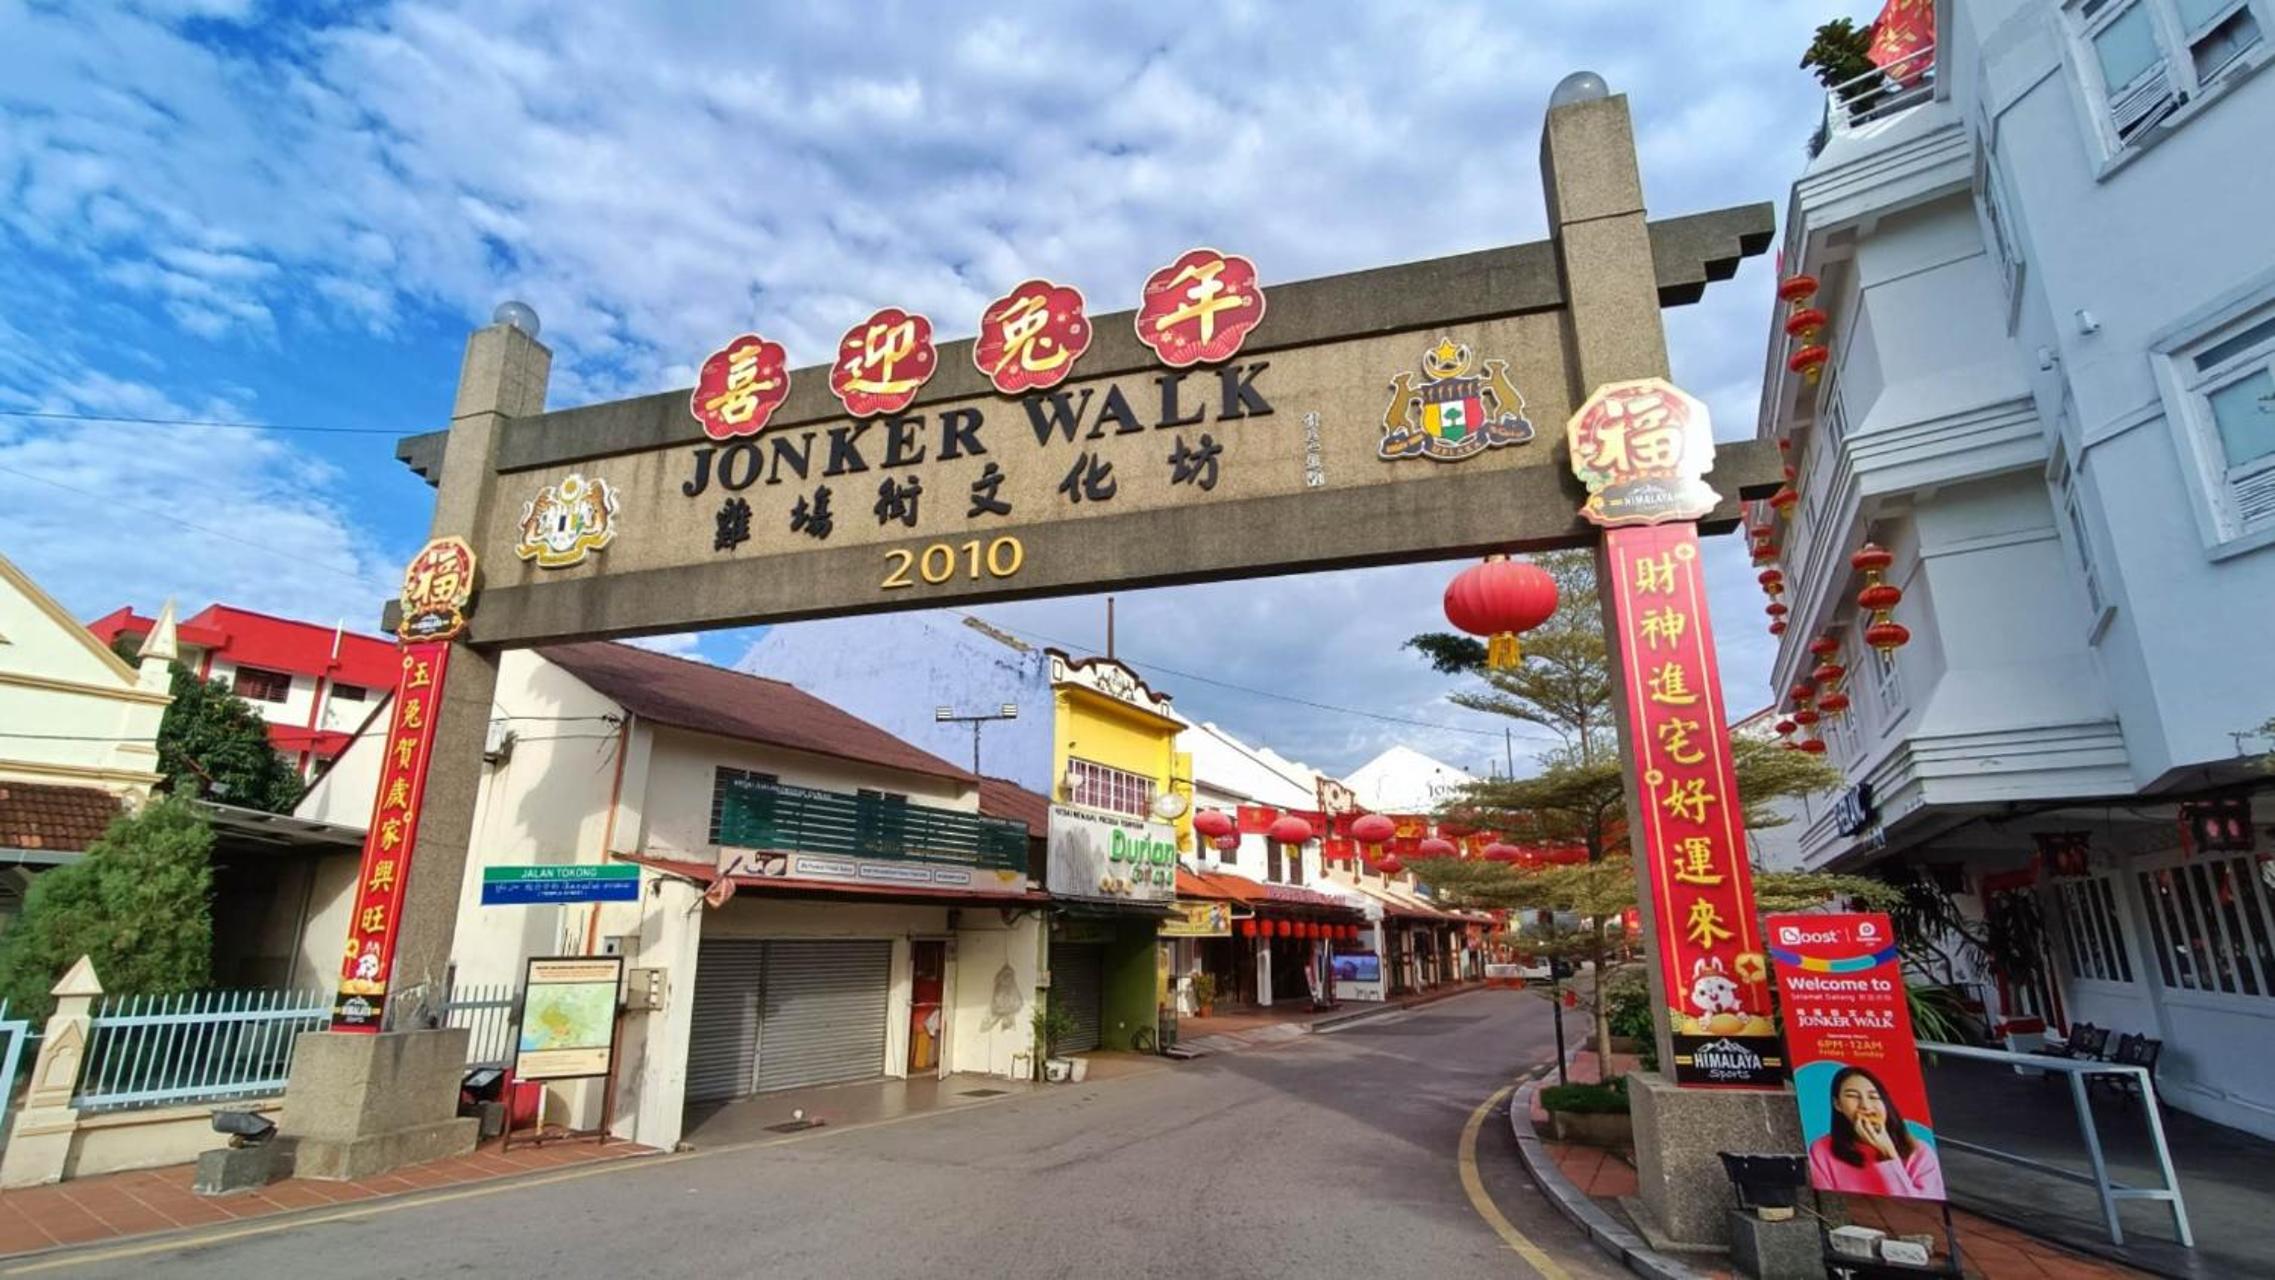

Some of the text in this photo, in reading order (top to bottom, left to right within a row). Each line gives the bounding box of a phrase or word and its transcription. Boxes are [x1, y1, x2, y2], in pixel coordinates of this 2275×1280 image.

[682, 361, 1274, 497] JONKER WALK
[1590, 395, 1683, 471] 福
[410, 549, 460, 604] 福
[881, 536, 1024, 588] 2010
[1635, 555, 1733, 950] 財神進宅好運來
[1110, 829, 1175, 865] Durian
[521, 867, 598, 879] JALAN TOKONG
[1786, 976, 1892, 992] Welcome to
[1798, 1015, 1894, 1028] JONKER WALK
[1694, 1053, 1763, 1070] HIMALAYA
[1708, 1068, 1751, 1081] Sports
